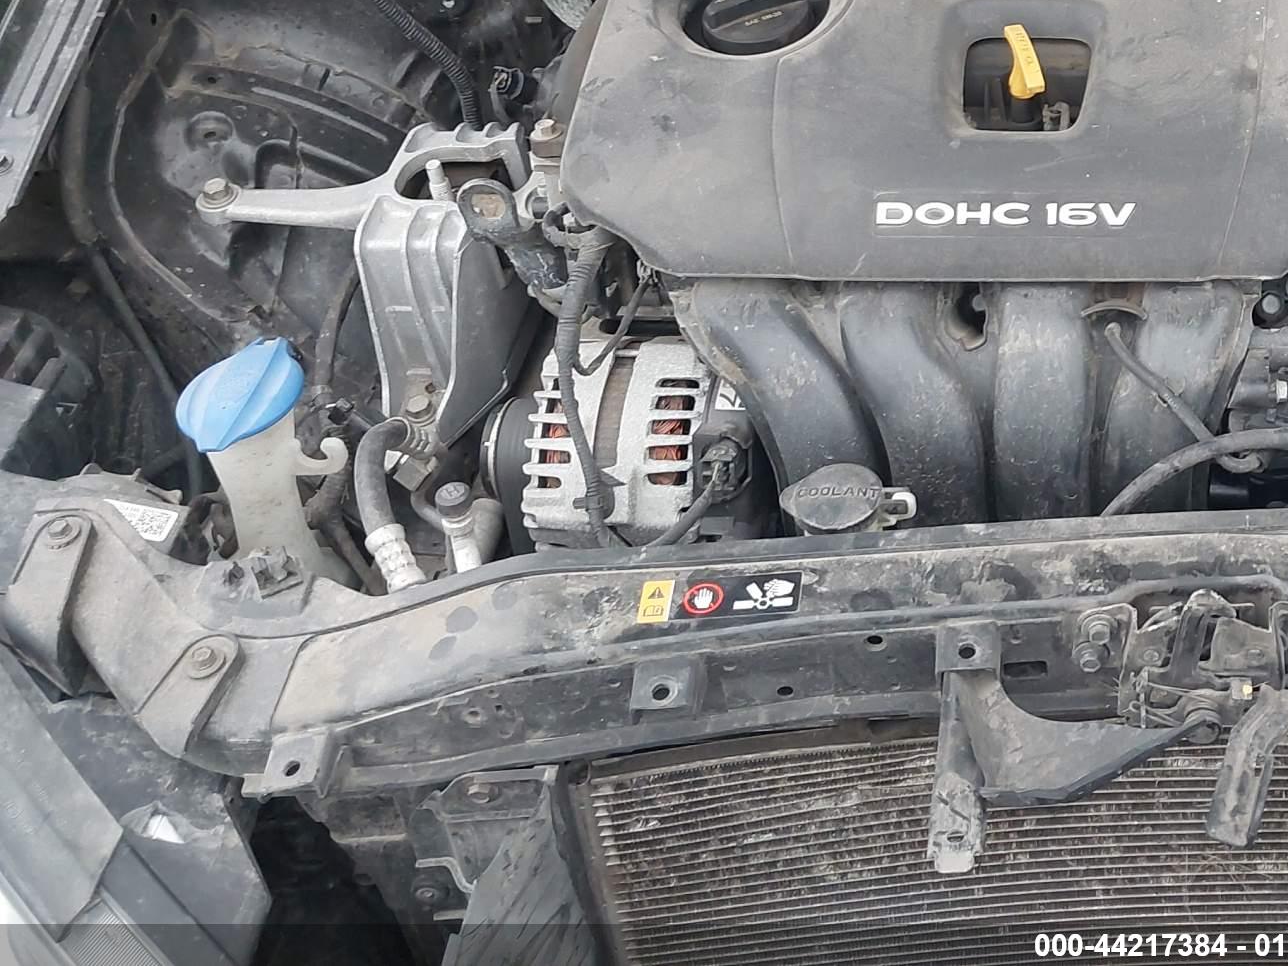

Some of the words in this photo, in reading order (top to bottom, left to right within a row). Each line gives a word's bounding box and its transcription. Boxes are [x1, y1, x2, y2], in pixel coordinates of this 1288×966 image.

[875, 201, 1031, 226] DOHC
[1045, 202, 1137, 227] 16V
[797, 485, 882, 499] COOLANT
